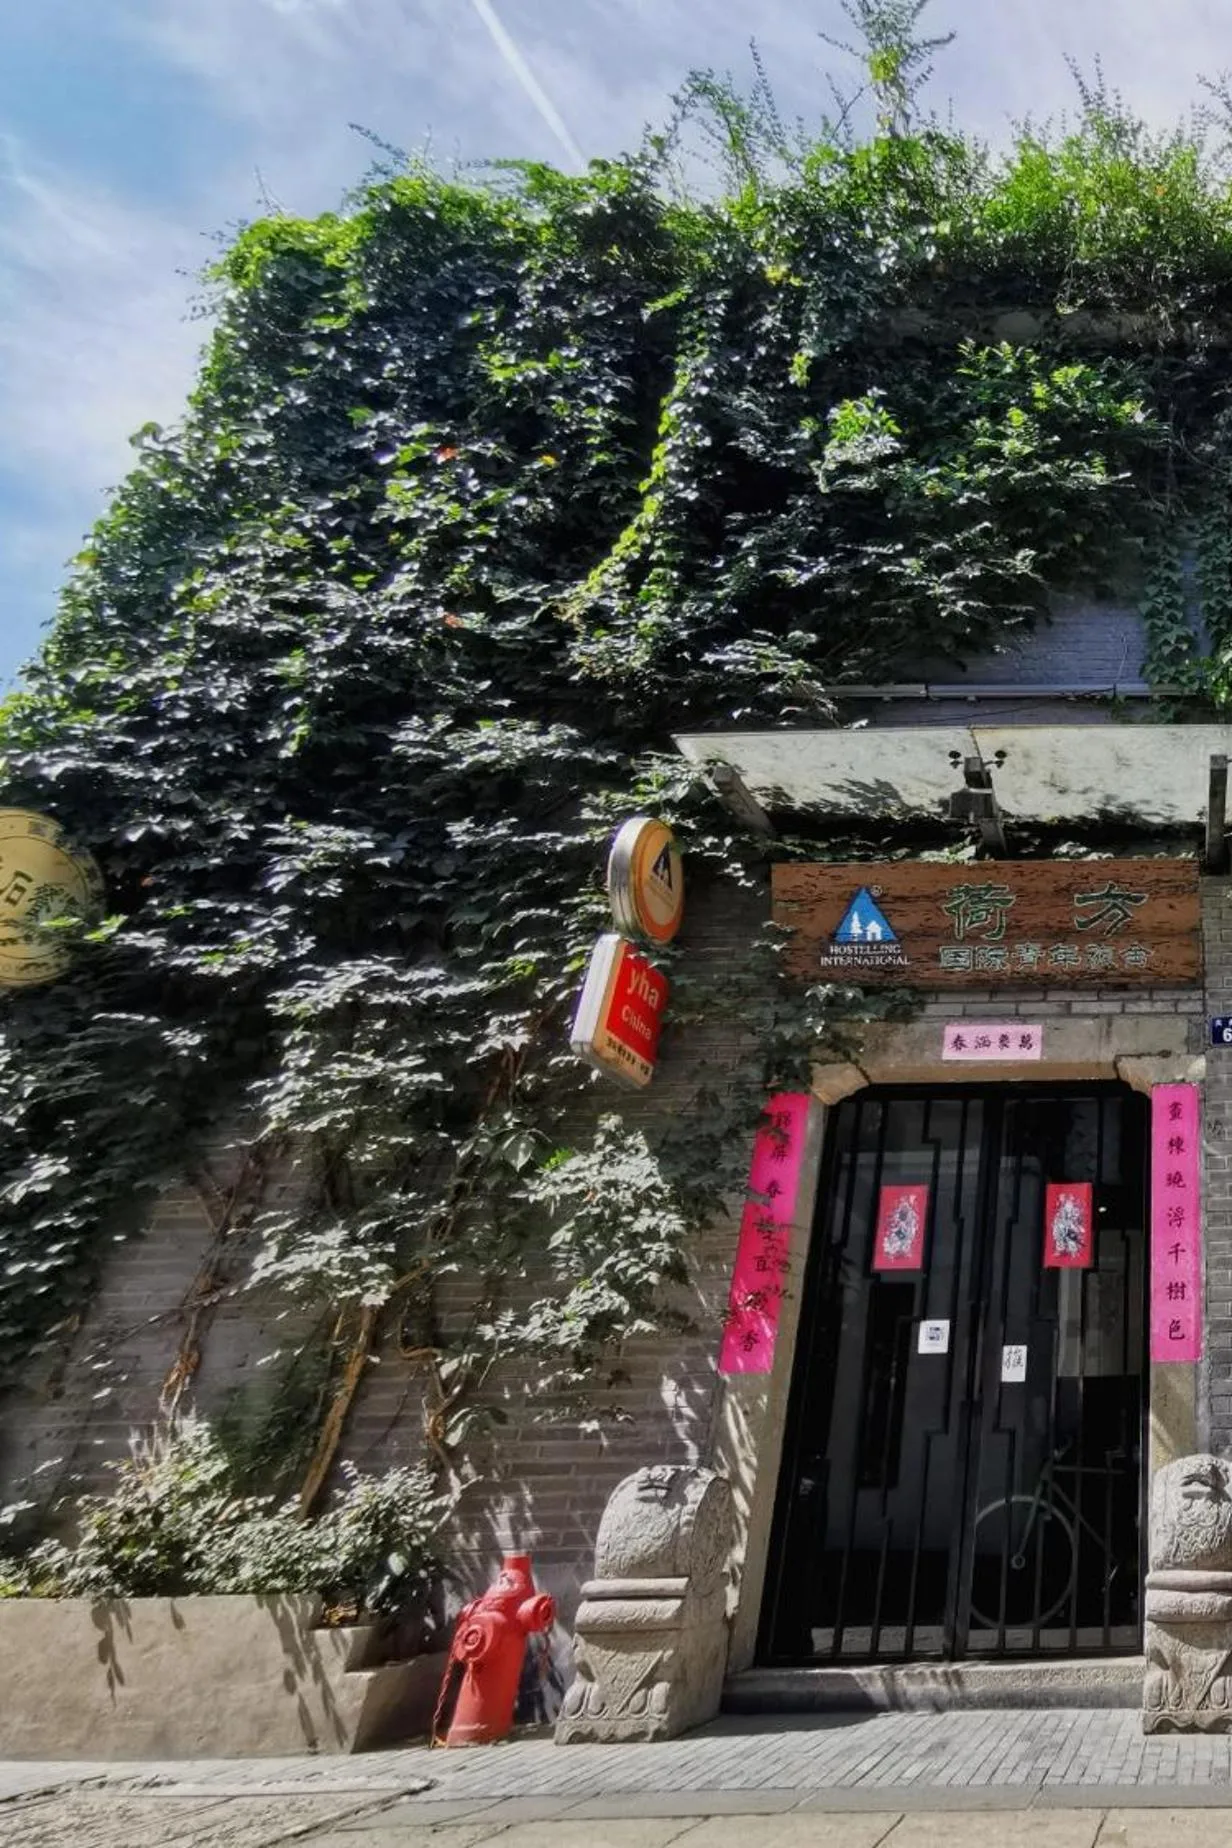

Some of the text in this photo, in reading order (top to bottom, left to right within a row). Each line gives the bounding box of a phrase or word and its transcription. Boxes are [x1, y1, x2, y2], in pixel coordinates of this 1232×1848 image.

[942, 880, 1149, 940] 荷方
[820, 955, 911, 967] INTERNATIONAL
[829, 943, 901, 955] HOSTELLING
[939, 941, 1154, 971] 国际青年旅舍
[627, 966, 660, 1009] yha
